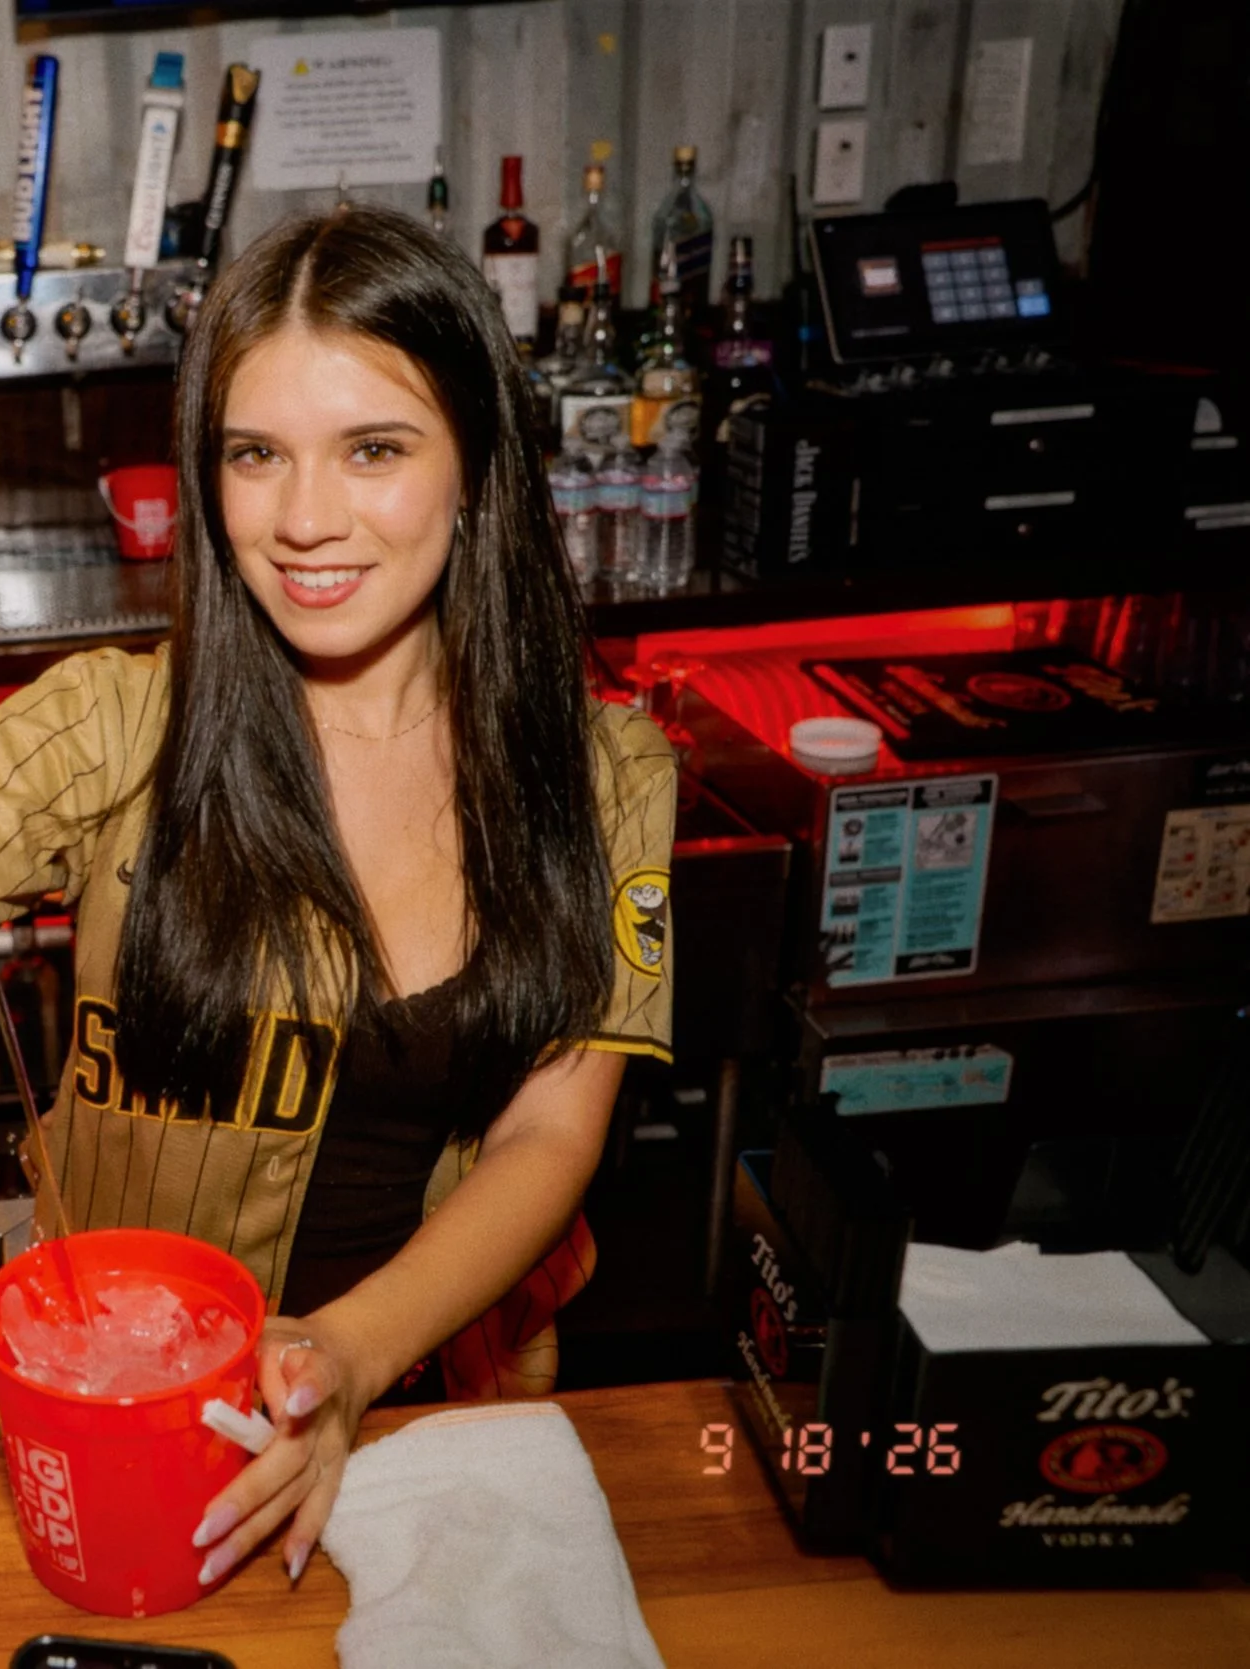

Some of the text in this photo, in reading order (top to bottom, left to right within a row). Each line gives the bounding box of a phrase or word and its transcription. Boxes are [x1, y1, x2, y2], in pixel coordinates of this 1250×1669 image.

[13, 87, 44, 241] BUD LIGHT
[750, 1231, 800, 1323] Tito's
[736, 1330, 793, 1431] Handmad
[1036, 1375, 1196, 1423] Tito's
[6, 1434, 67, 1491] IG
[16, 1470, 71, 1522] ED
[999, 1492, 1191, 1528] Handmade
[22, 1501, 76, 1548] UP
[1040, 1531, 1137, 1549] VODKA
